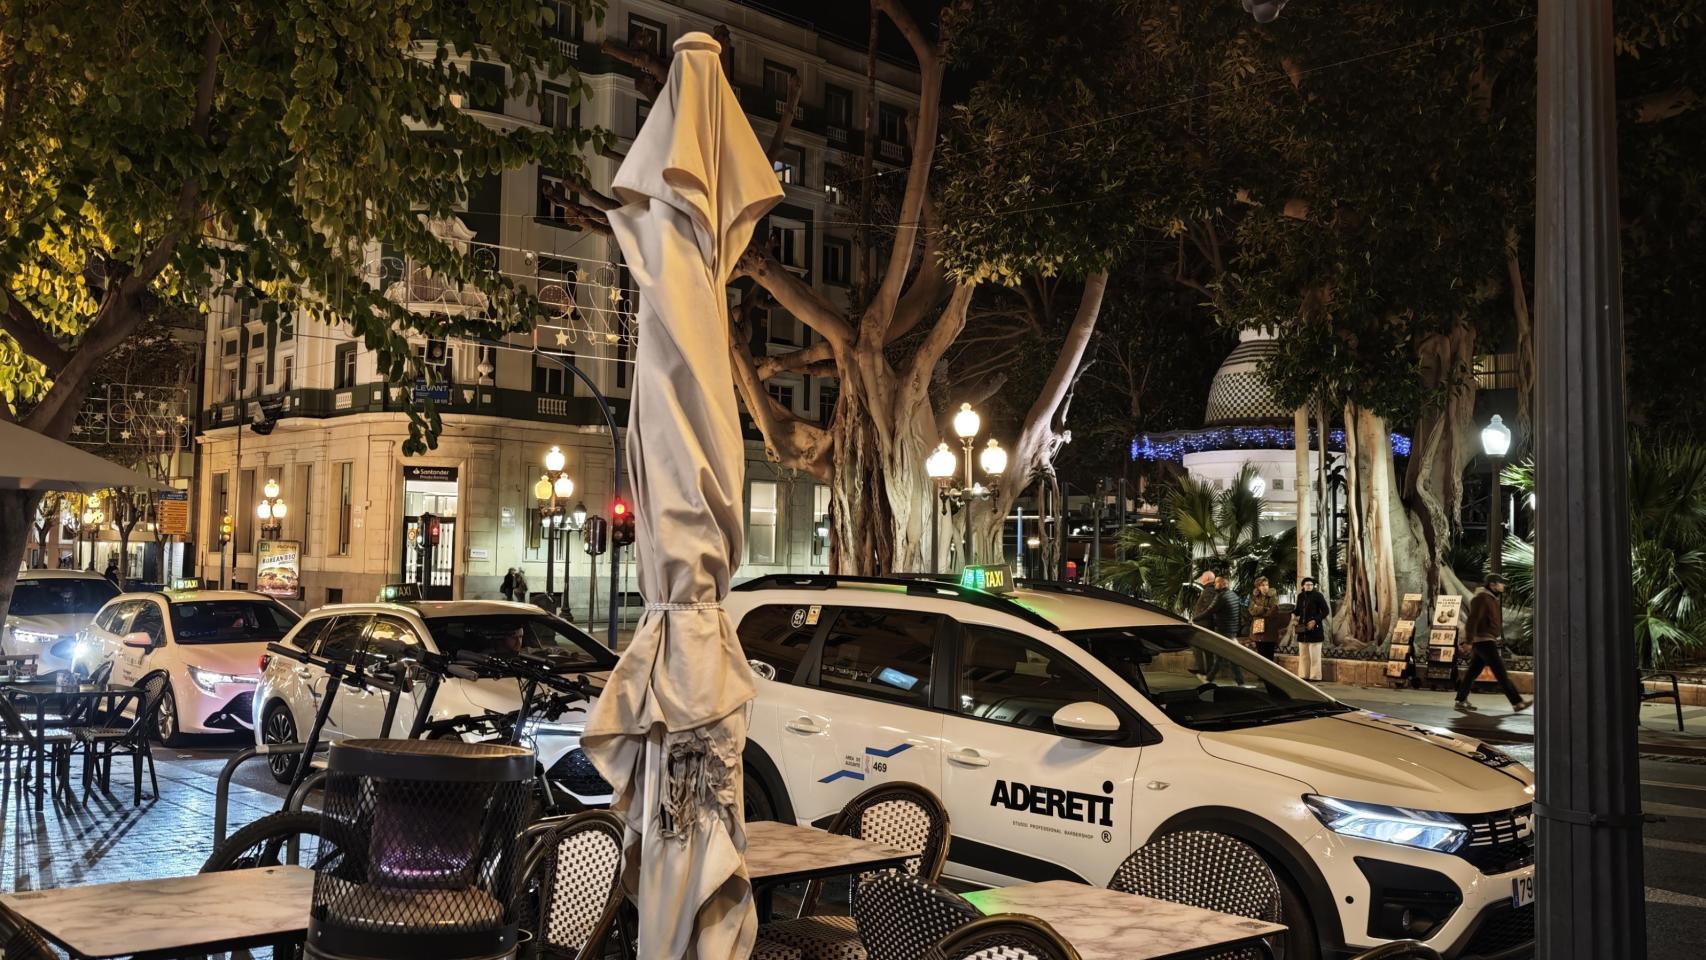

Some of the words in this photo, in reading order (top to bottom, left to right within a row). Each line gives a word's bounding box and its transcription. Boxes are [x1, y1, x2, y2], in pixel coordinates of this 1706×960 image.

[184, 580, 199, 589] TAXI
[985, 570, 1004, 588] TAXI
[393, 586, 412, 597] TAXI
[873, 762, 887, 773] 469
[1029, 823, 1062, 834] PROFESSIONAL
[1064, 830, 1094, 840] BARBERSHOP
[1520, 876, 1535, 902] 79
